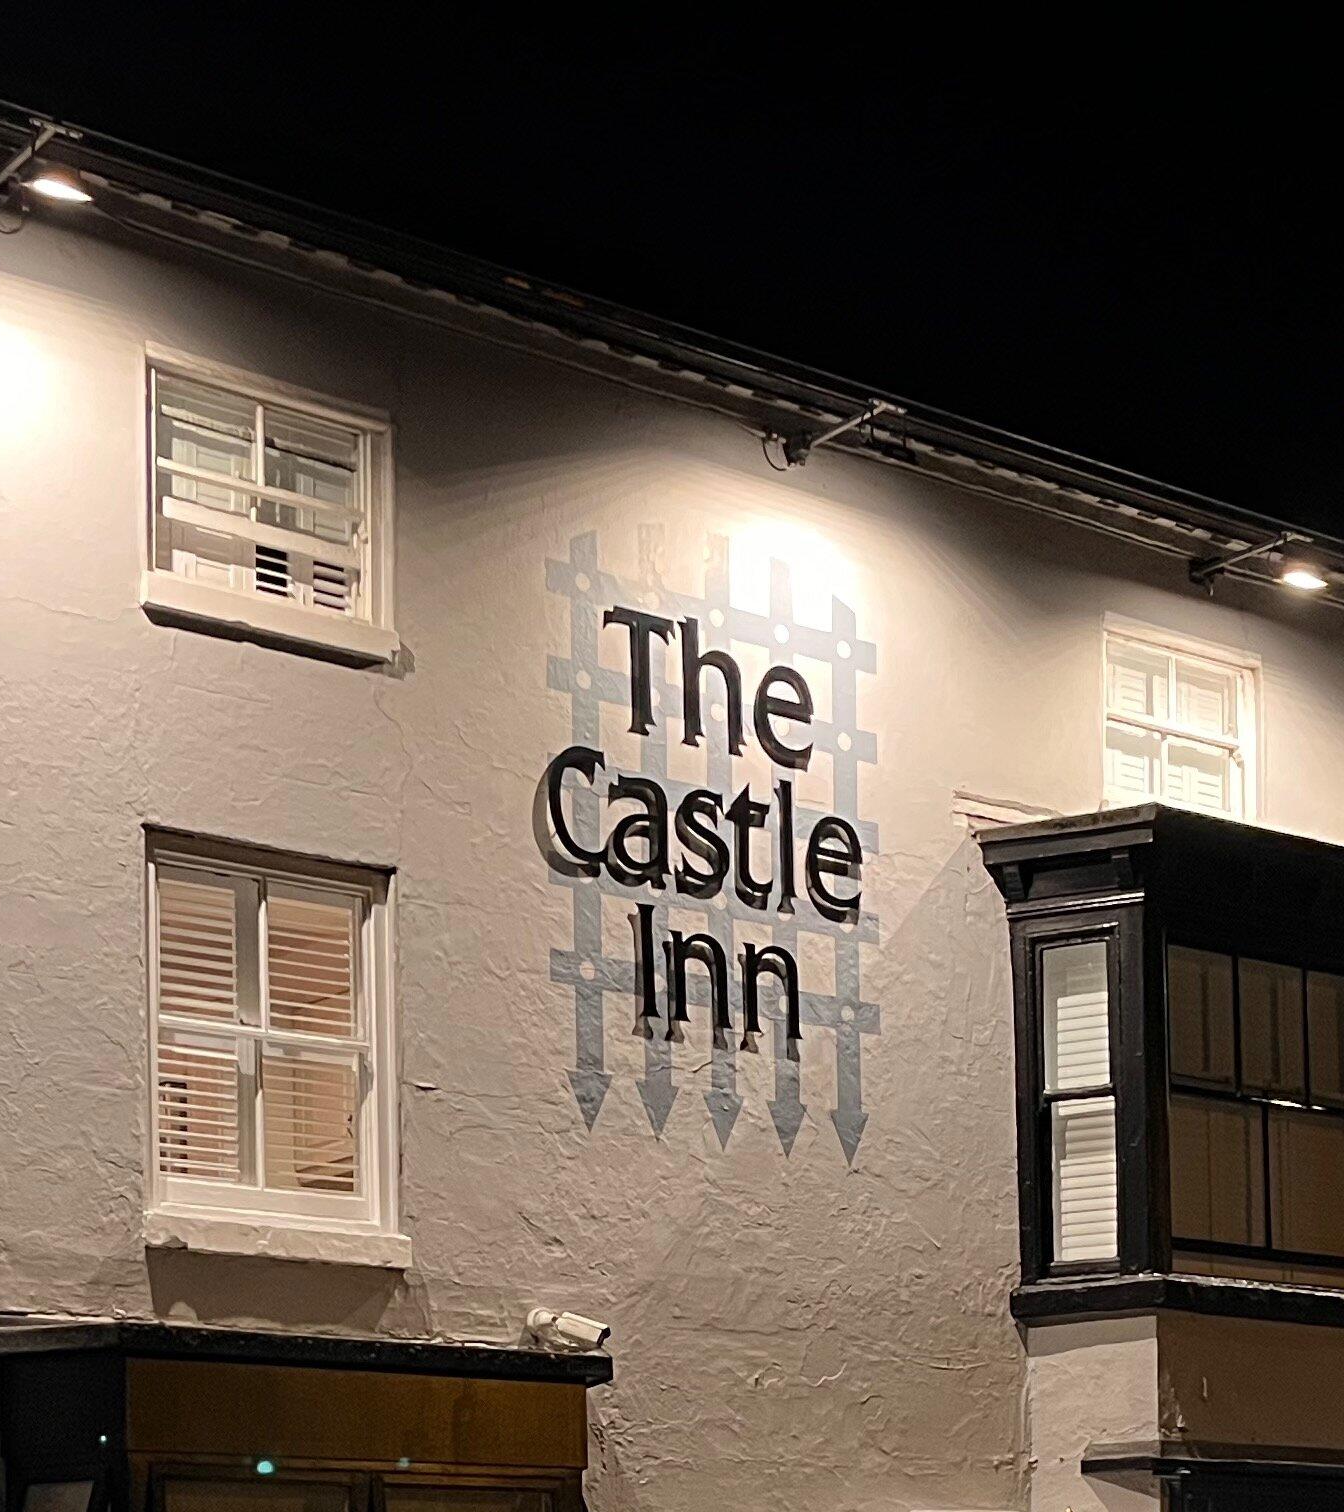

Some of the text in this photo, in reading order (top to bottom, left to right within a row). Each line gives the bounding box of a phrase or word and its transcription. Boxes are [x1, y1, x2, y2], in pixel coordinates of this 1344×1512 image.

[602, 604, 815, 772] The
[536, 745, 863, 924] Castle
[630, 902, 804, 1043] Inn
